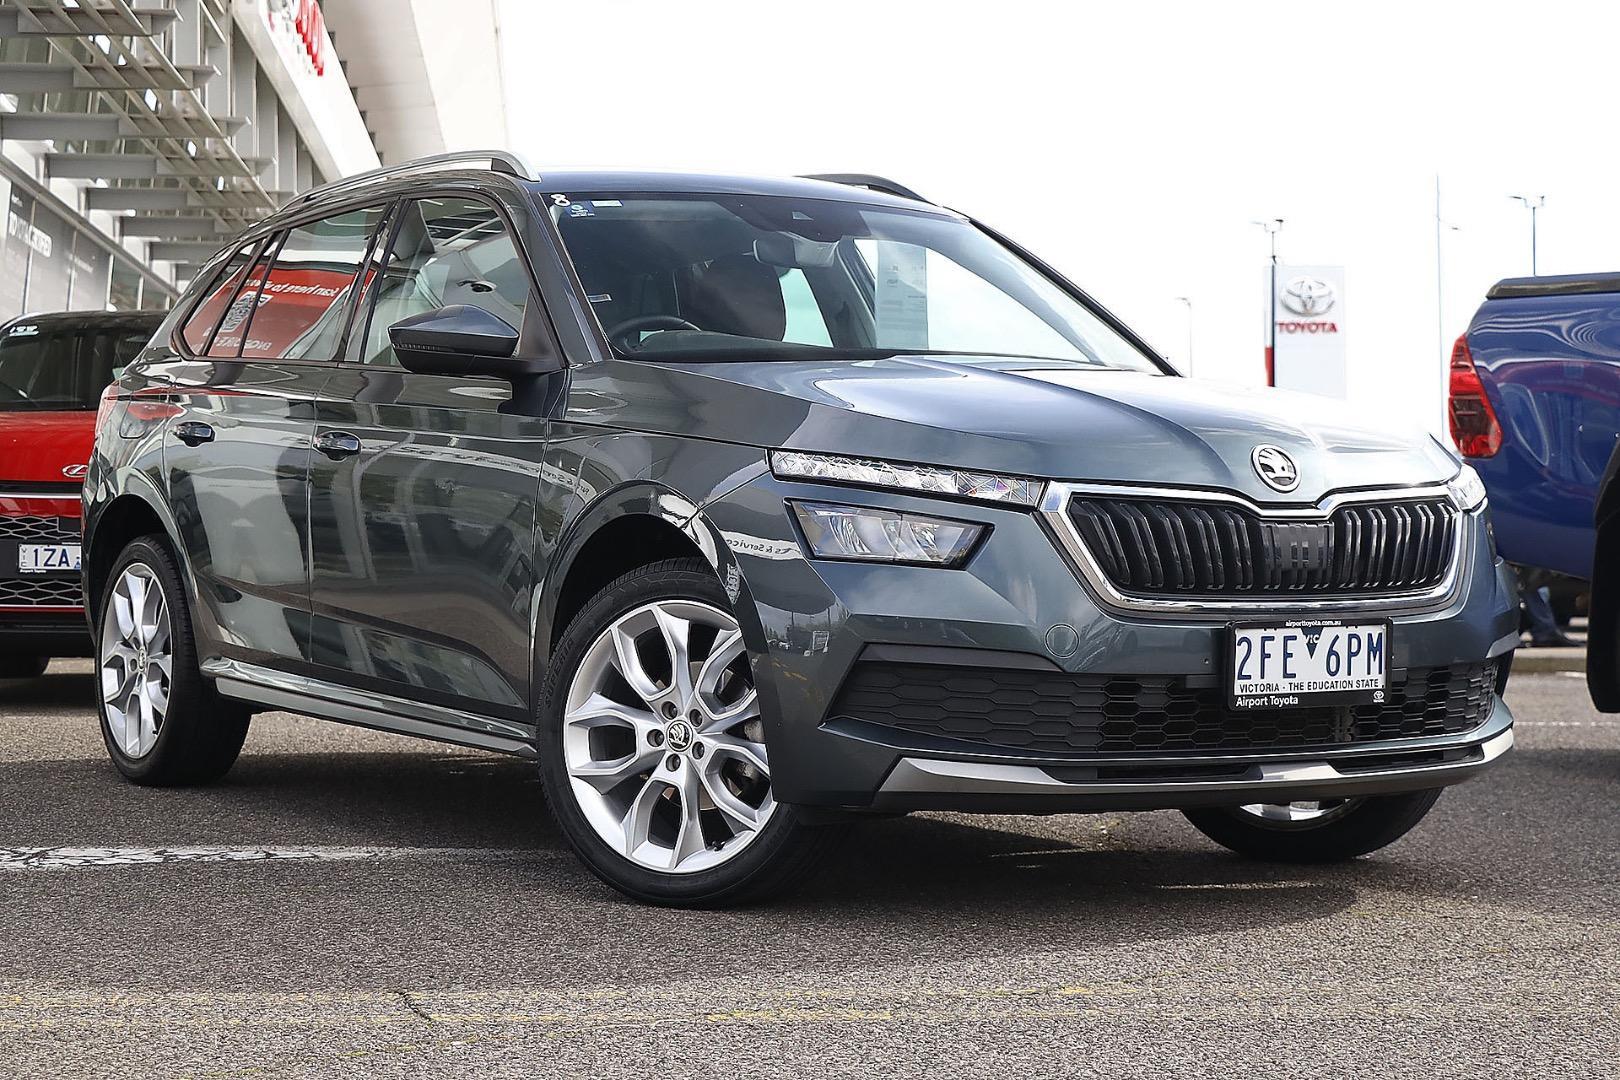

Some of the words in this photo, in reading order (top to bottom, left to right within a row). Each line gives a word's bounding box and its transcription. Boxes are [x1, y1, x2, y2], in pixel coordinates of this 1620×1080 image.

[1279, 322, 1337, 334] TOYOTA
[1285, 620, 1342, 628] airporttoyota.com.au
[1306, 634, 1320, 644] VIC
[1237, 635, 1298, 680] 2FE
[1326, 632, 1383, 677] 6PM
[1239, 683, 1280, 694] VICTORIA
[1288, 681, 1304, 692] THE
[1307, 679, 1353, 691] EDUCATION
[1356, 678, 1379, 689] STATE
[1236, 696, 1268, 709] Airport
[1269, 695, 1299, 707] Toyota
